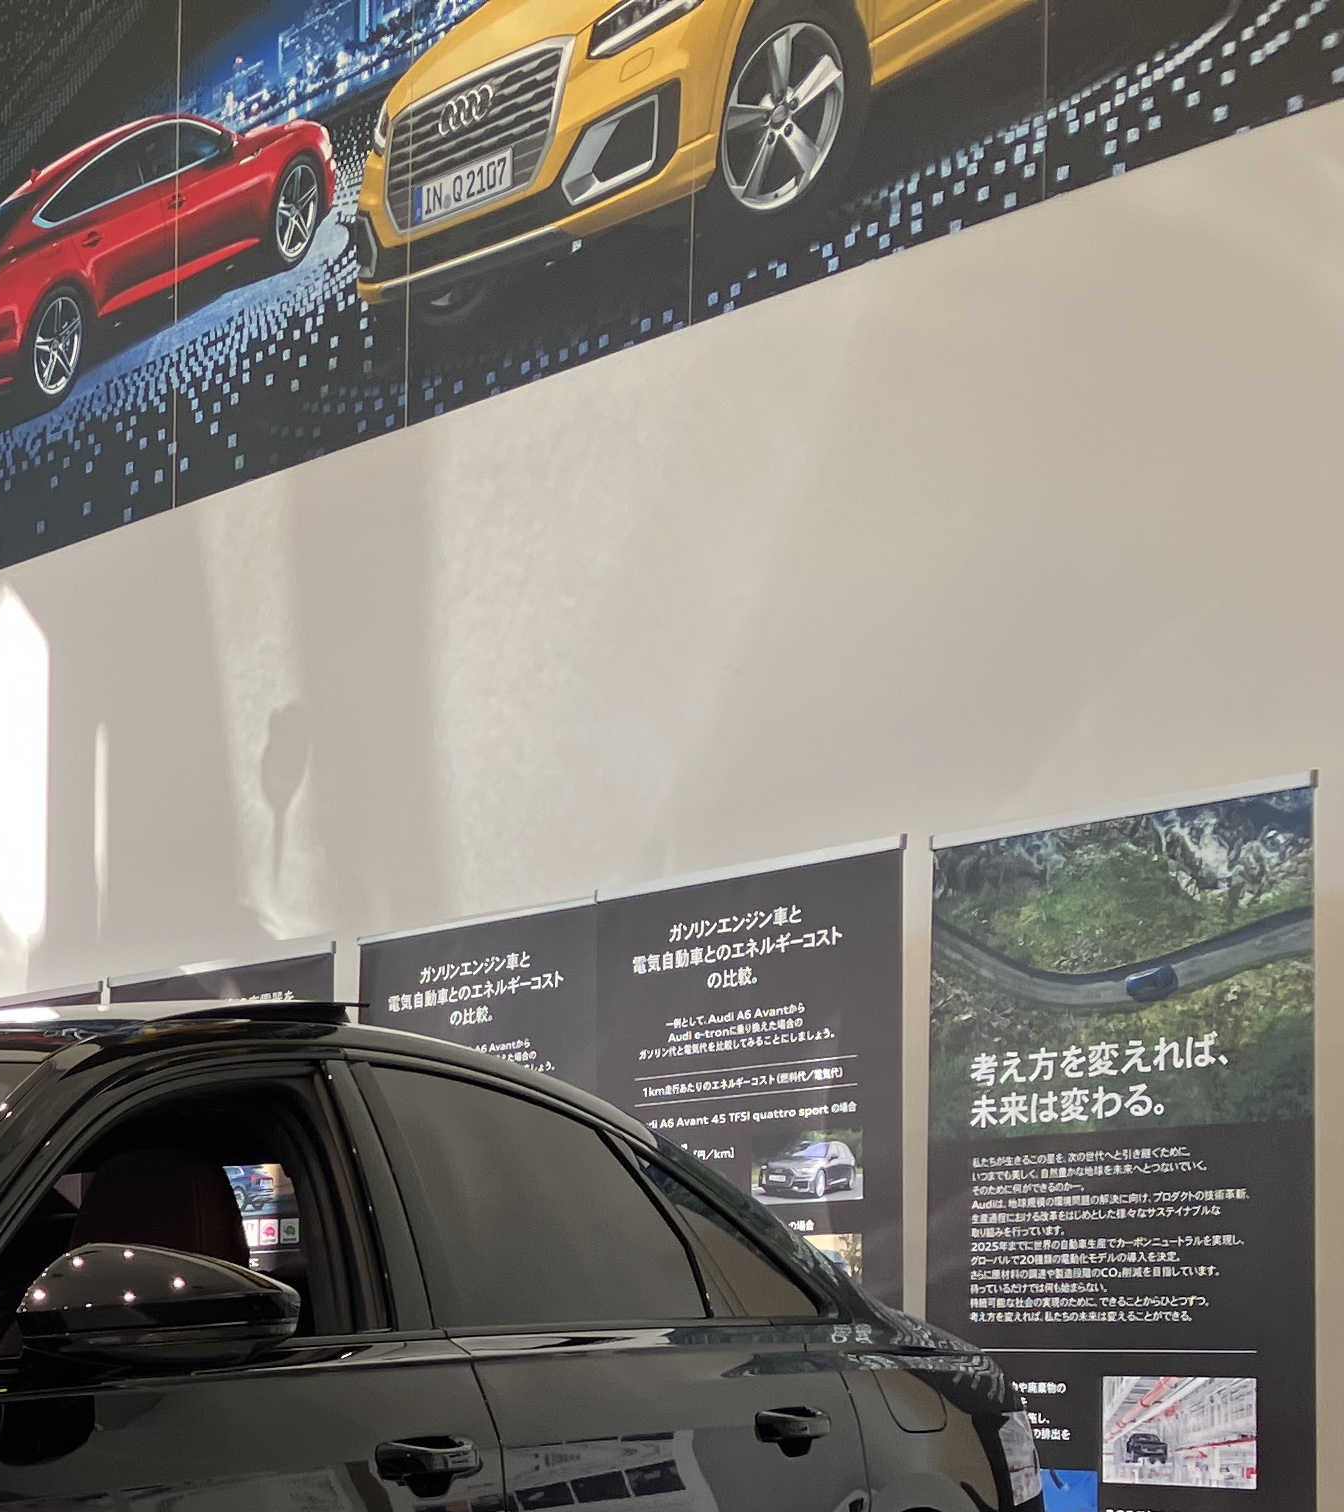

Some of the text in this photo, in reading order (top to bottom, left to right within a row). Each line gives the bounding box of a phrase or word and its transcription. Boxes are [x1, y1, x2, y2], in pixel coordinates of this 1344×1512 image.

[425, 157, 507, 215] IN Q 2107
[669, 905, 802, 942] ガソリンエンジン車と
[419, 951, 531, 984] ガソリンエンジン車と
[632, 927, 843, 974] 電気自動車とのエネルギーコスト
[388, 971, 564, 1012] 電気自動車とのエネルギーコスト
[707, 967, 758, 989] の比較。
[450, 1005, 493, 1026] の比較。
[736, 1009, 752, 1021] A6
[754, 1002, 805, 1019] Avantから
[668, 1030, 692, 1043] Audi
[970, 1031, 1228, 1087] 考え方を変えれば、
[660, 1117, 674, 1129] A6
[676, 1115, 709, 1127] Avant
[711, 1113, 726, 1125] 45
[728, 1111, 750, 1123] TFSI
[752, 1108, 796, 1123] quattro
[798, 1104, 828, 1119] sport
[970, 1083, 1166, 1129] 未来は変わる。
